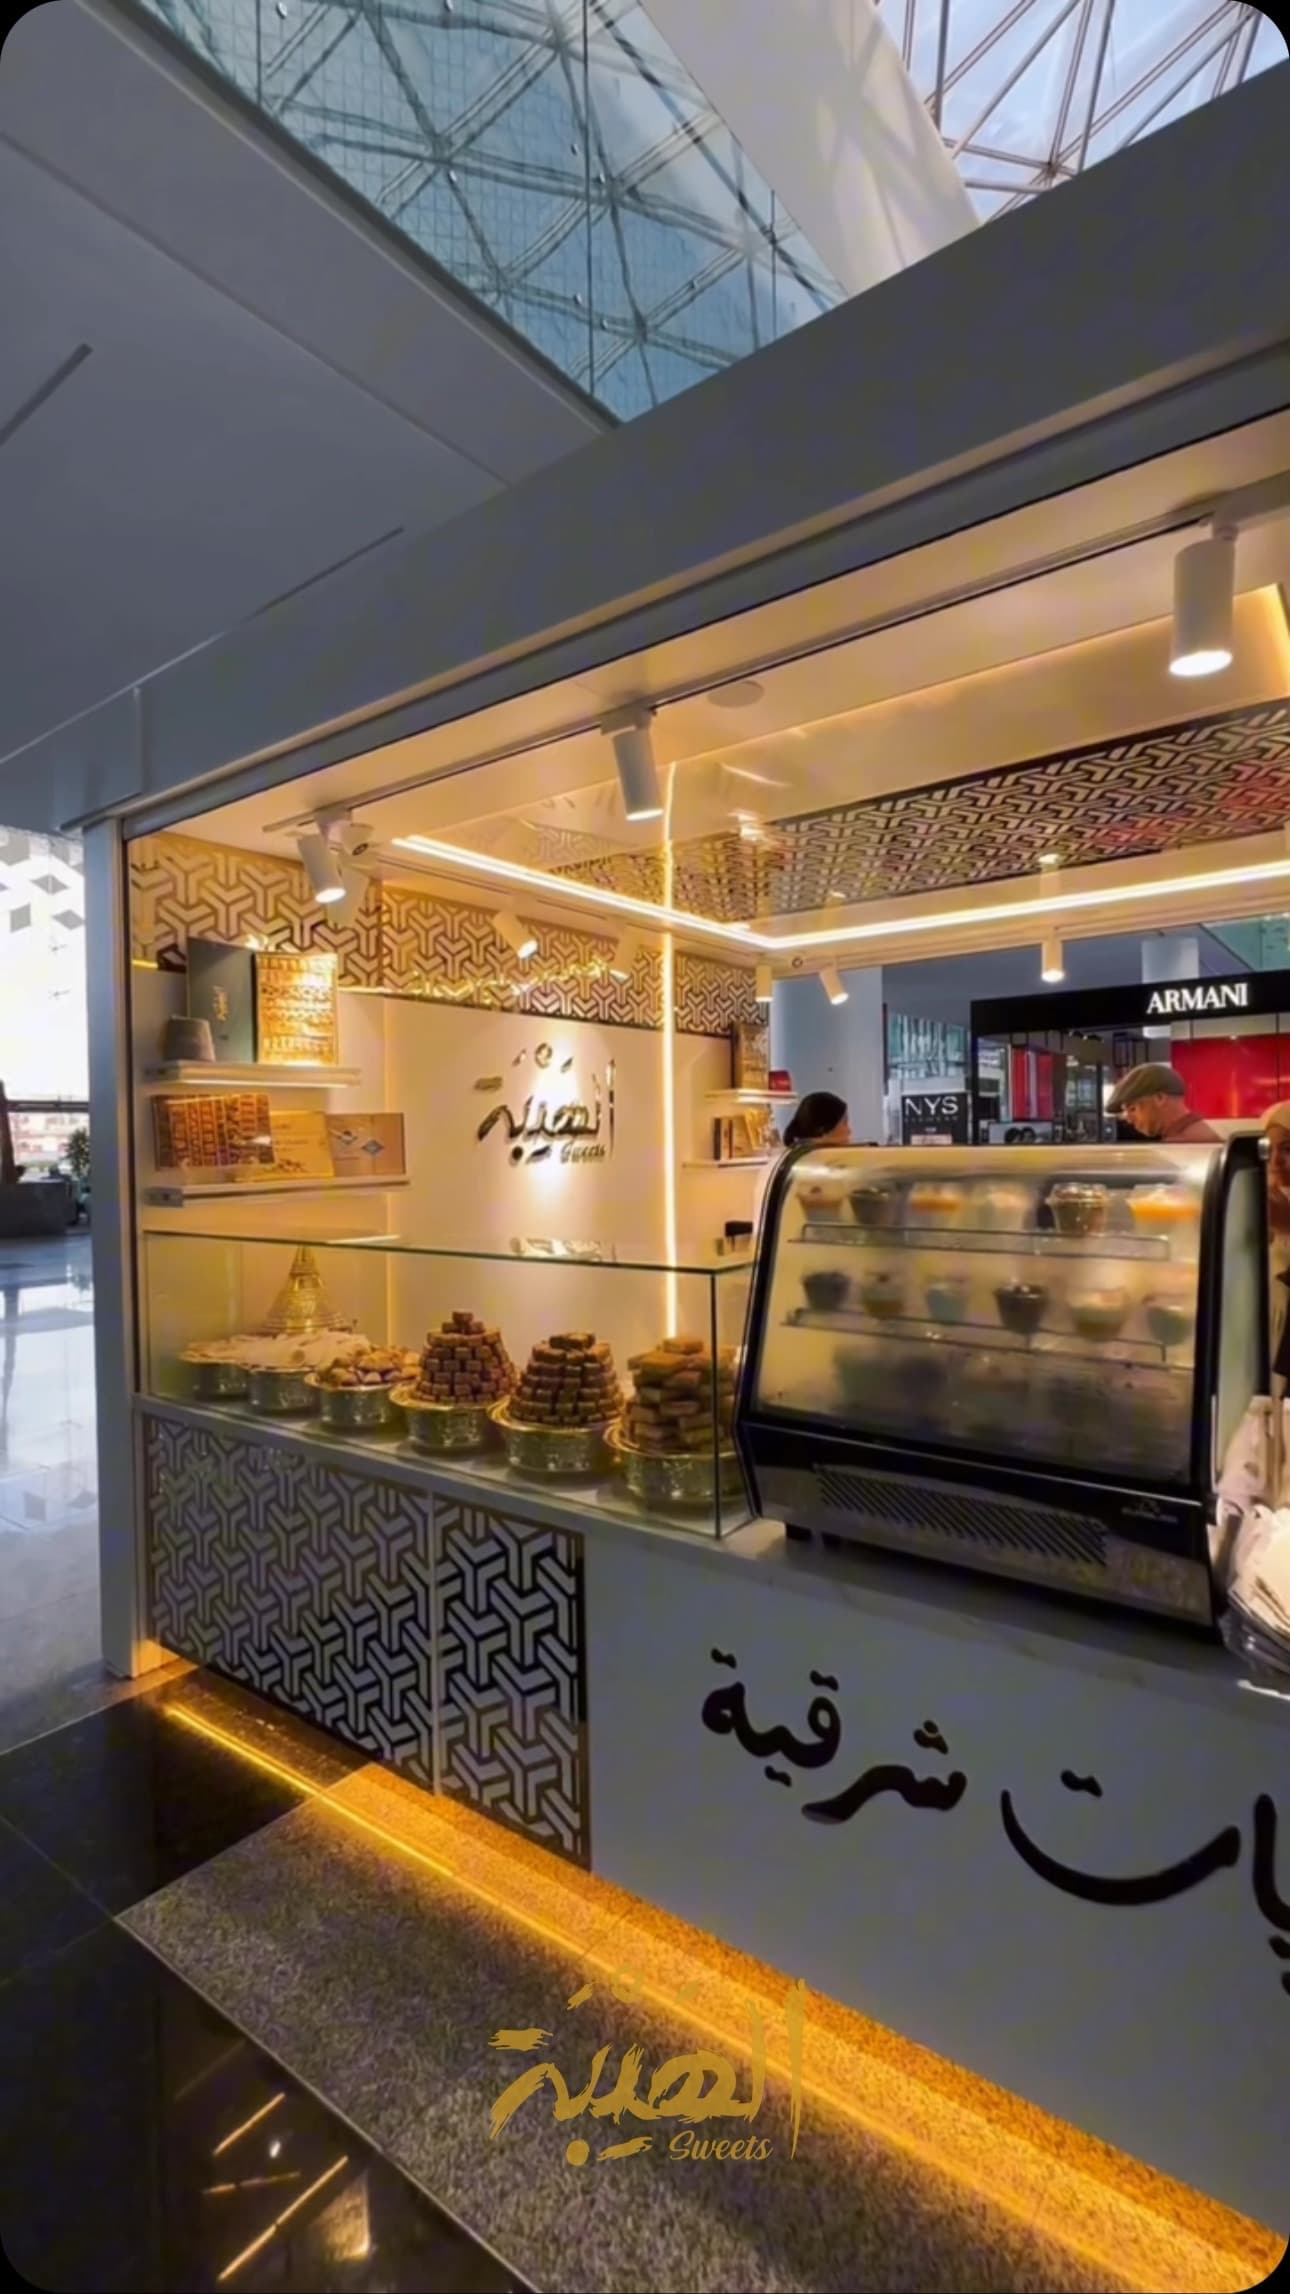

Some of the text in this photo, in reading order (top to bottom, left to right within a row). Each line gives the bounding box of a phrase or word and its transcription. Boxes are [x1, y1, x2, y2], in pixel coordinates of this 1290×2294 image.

[1146, 982, 1249, 1015] ARMANI
[904, 1095, 960, 1116] NYS
[702, 1648, 967, 1824] شرقية
